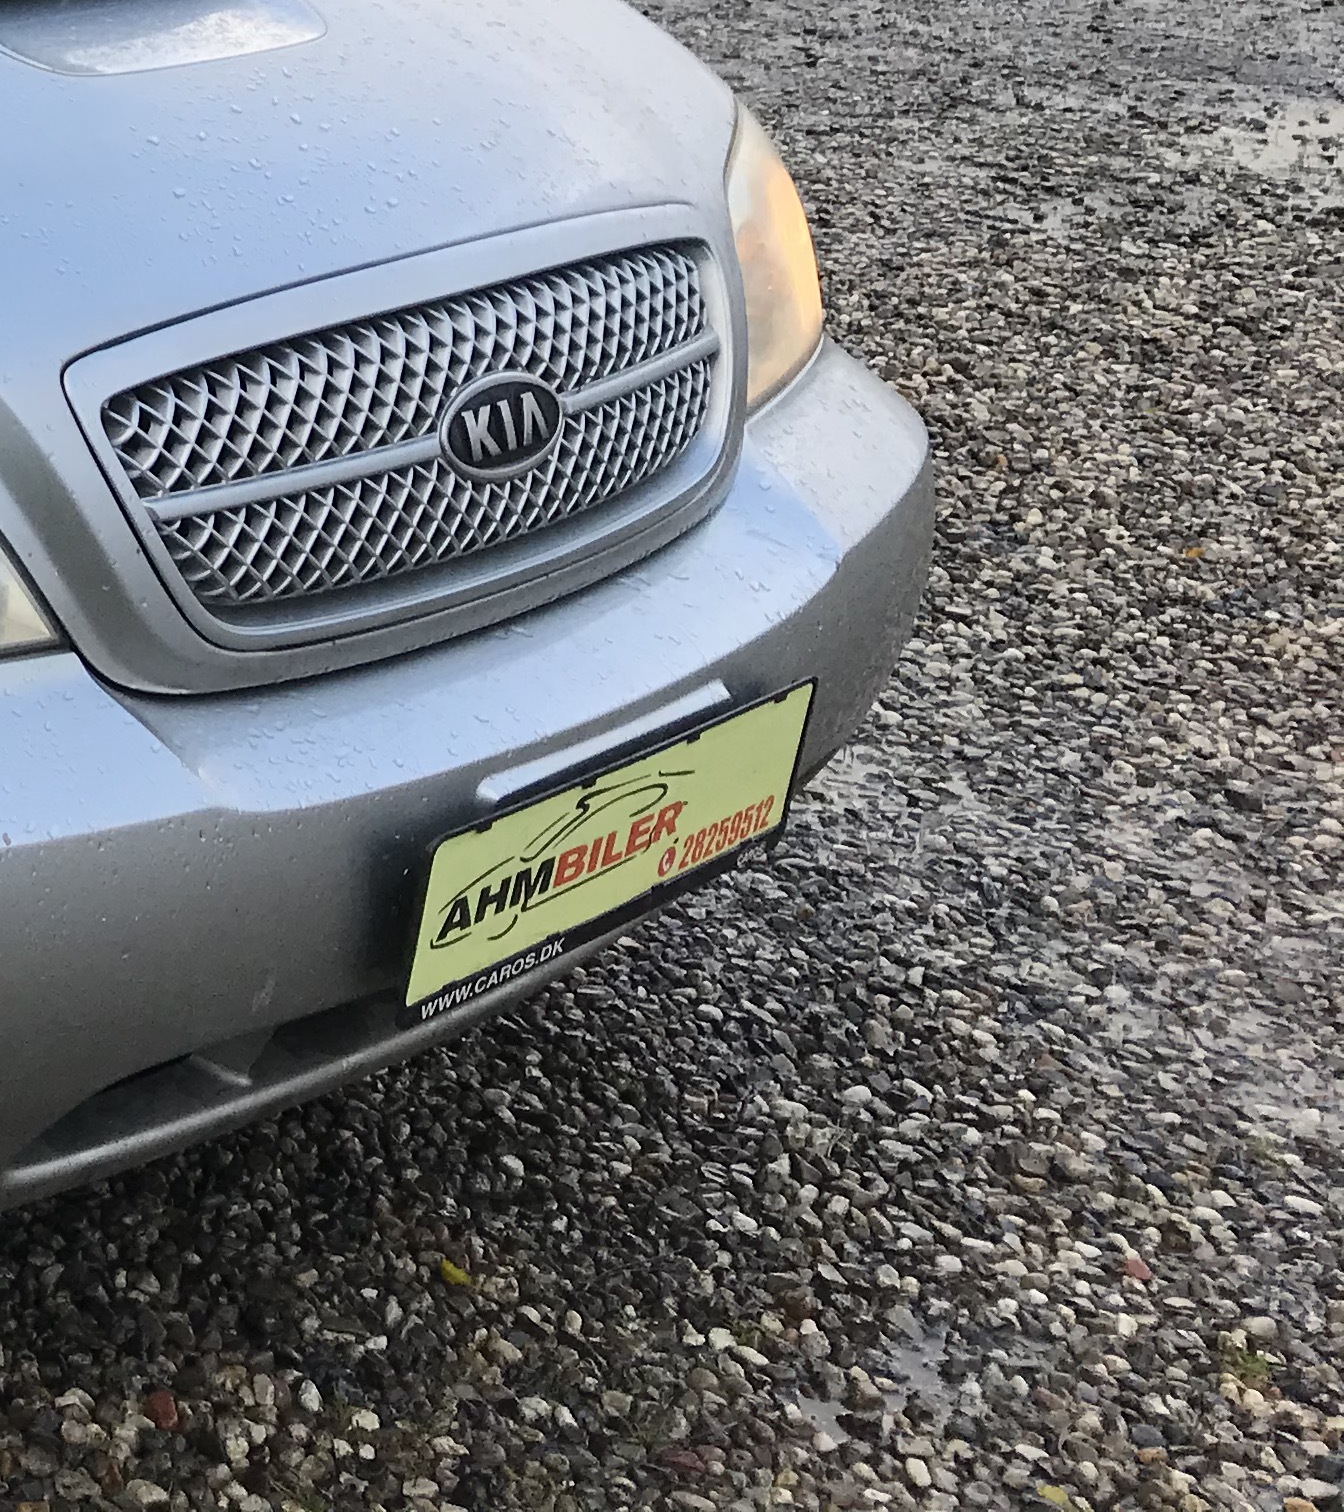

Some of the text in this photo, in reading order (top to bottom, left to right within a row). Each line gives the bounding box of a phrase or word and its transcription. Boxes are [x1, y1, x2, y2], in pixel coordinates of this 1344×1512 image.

[461, 390, 551, 463] KIA
[435, 799, 684, 942] AHMBILER
[677, 794, 775, 871] 28259512
[420, 937, 566, 1020] WWW.CAROS.DK
